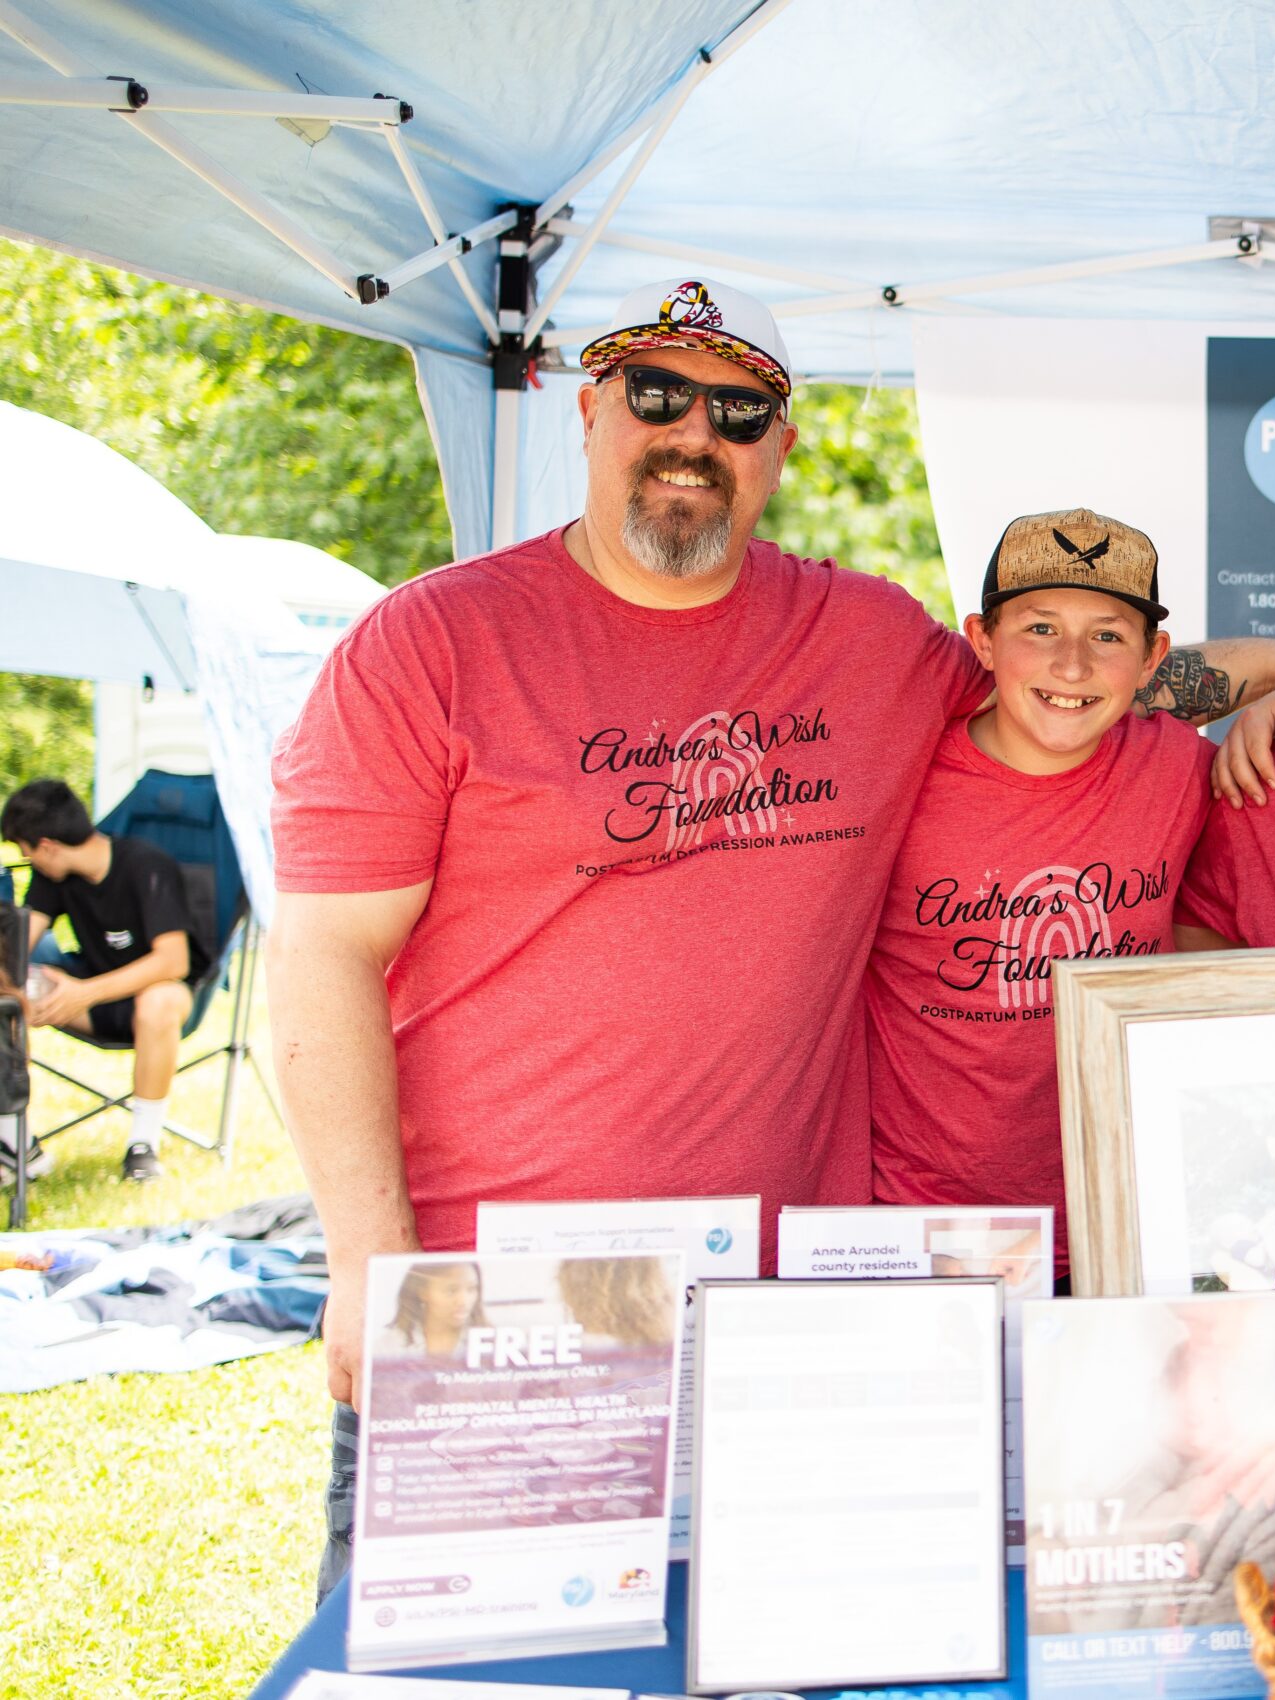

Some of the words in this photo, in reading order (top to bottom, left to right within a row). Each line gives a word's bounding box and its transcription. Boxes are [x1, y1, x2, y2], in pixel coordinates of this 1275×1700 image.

[1217, 570, 1275, 586] Contact
[579, 716, 723, 774] Andrea's
[728, 707, 831, 753] Wish
[604, 767, 838, 843] Foundation
[676, 836, 774, 861] DEPRESSION
[779, 826, 866, 846] AWARENESS
[915, 872, 1069, 927] Andrea's
[1074, 859, 1170, 914] Wish
[920, 1005, 1017, 1024] POSTPARTUM
[811, 1247, 845, 1257] Anne
[811, 1260, 855, 1273] county
[859, 1259, 918, 1271] residents
[466, 1323, 584, 1369] FREE
[596, 1405, 672, 1420] MARYLAND
[1039, 1503, 1055, 1538] 1
[1064, 1500, 1098, 1537] IN
[1103, 1498, 1125, 1535] 7
[1035, 1541, 1187, 1586] MOTHERS
[1041, 1640, 1082, 1662] CALL
[1084, 1638, 1105, 1659] OR
[1108, 1634, 1149, 1657] TEXT
